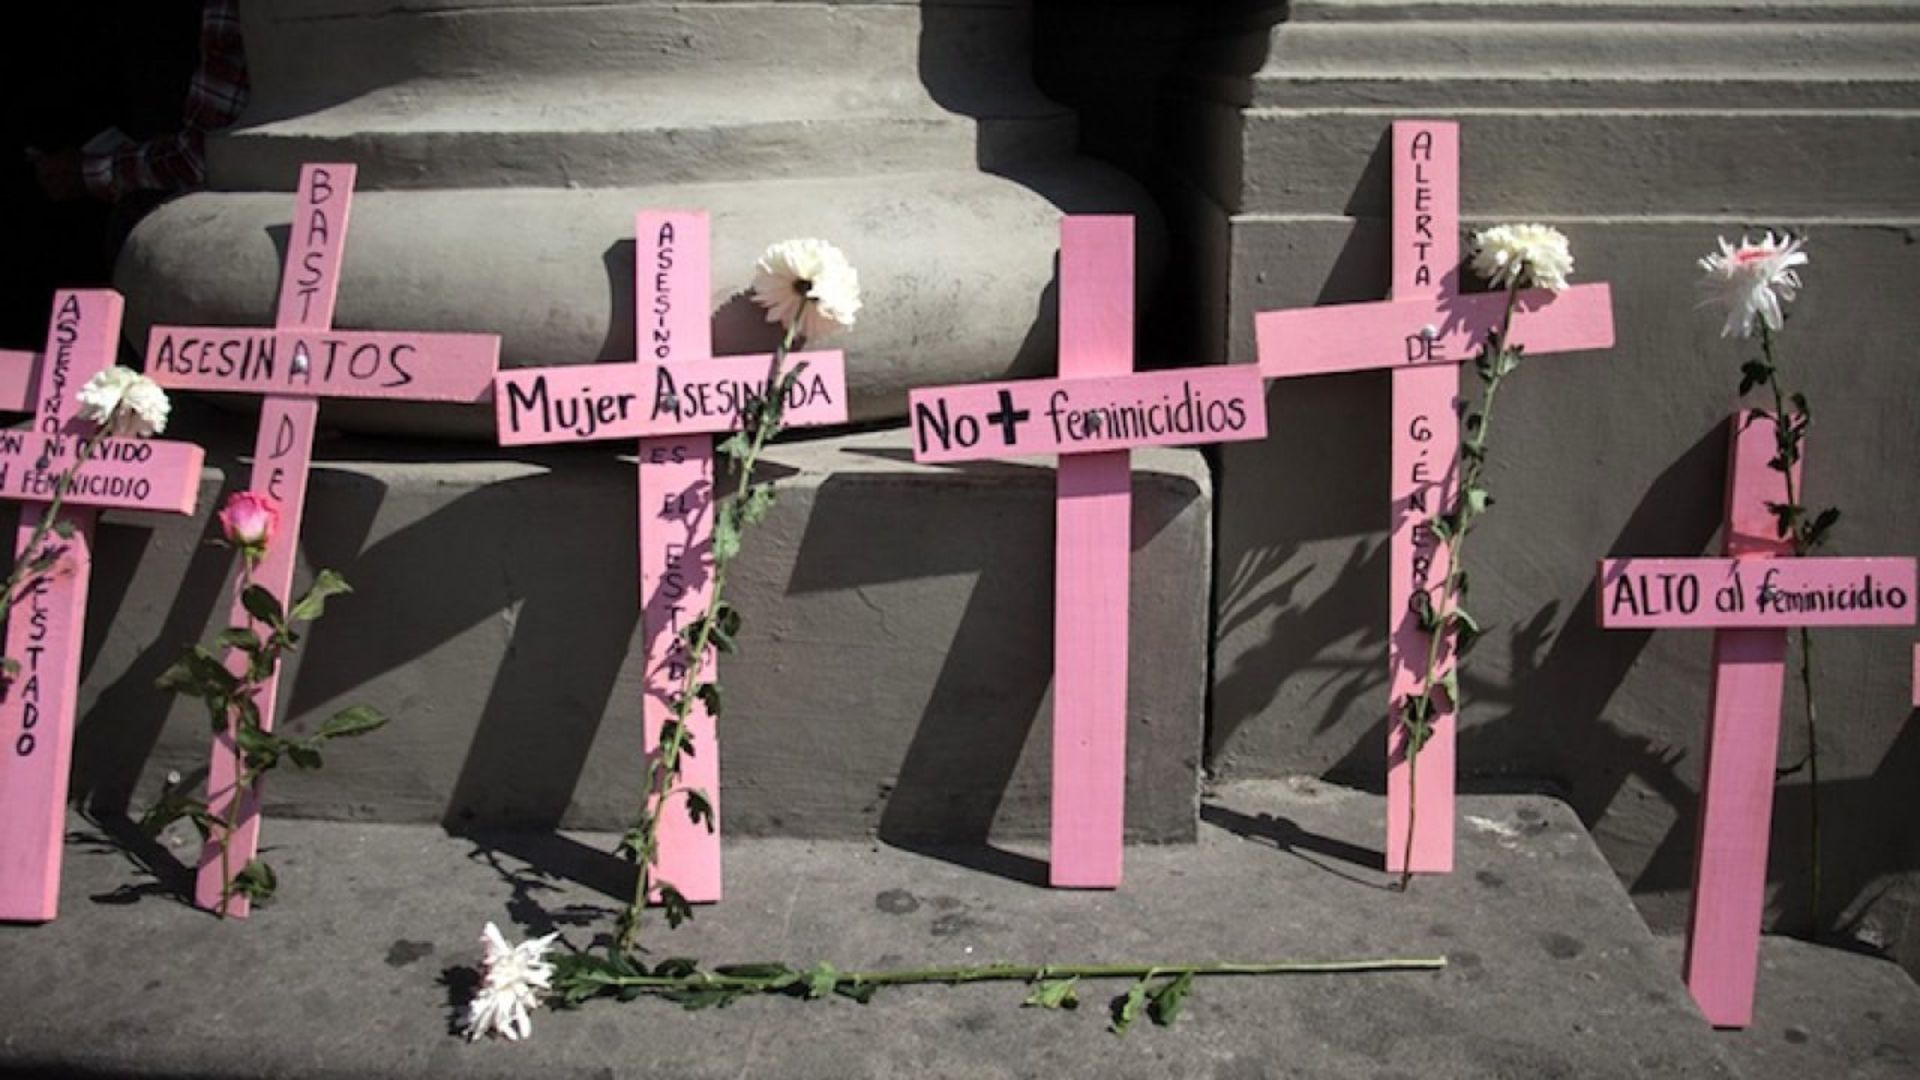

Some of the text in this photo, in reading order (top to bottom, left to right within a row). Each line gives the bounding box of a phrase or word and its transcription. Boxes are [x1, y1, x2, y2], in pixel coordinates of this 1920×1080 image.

[1411, 130, 1434, 287] ALERTA
[651, 221, 675, 359] ASESINO
[155, 335, 417, 388] ASESINATOS
[1405, 334, 1447, 362] DE
[506, 366, 832, 437] Mujer ASESINDA
[1044, 380, 1248, 444] feminicidios
[21, 469, 151, 501] FEMNICIDIO
[1612, 572, 1699, 616] ALTO
[1756, 567, 1908, 615] feminicidio
